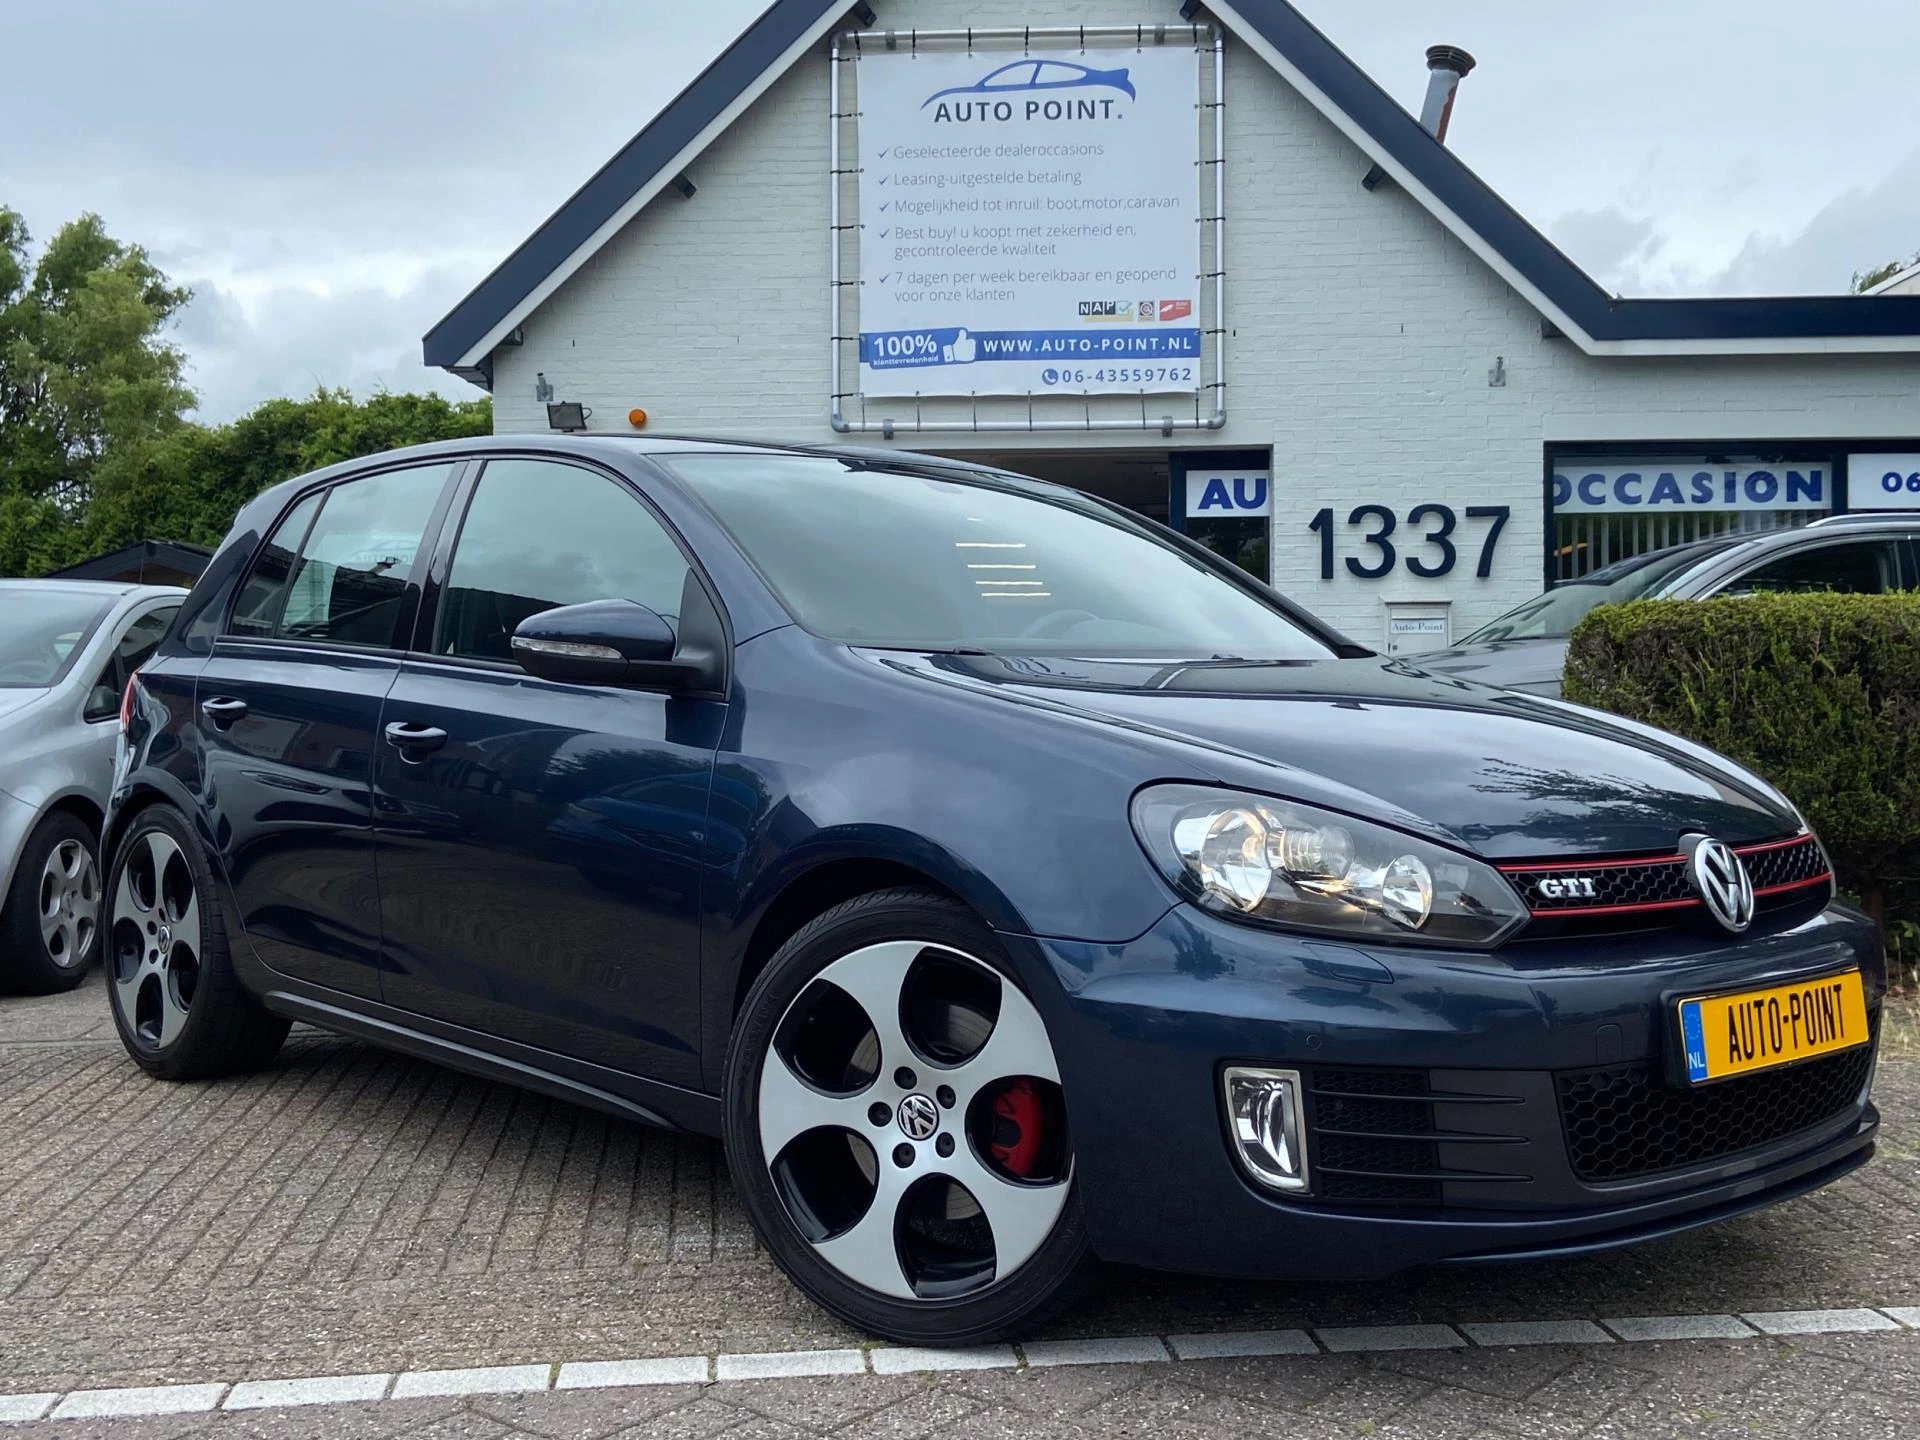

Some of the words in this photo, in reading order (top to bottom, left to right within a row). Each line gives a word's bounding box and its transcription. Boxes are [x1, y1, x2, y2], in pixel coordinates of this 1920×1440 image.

[934, 101, 1012, 122] AUTO
[894, 145, 991, 159] Geselecteerde
[995, 143, 1104, 157] dealeroccasions
[894, 171, 1024, 188] Leasing-uitgestelde
[1028, 169, 1082, 185] betaling
[895, 199, 978, 215] Mogelijkheid
[983, 199, 1001, 211] tot
[1047, 196, 1180, 211] boot,motor,caravan
[895, 226, 925, 239] Best
[928, 225, 956, 241] buy!
[960, 228, 969, 238] u
[973, 224, 1012, 240] koopt
[1016, 226, 1042, 238] met
[1046, 224, 1112, 237] zekerheid
[894, 244, 999, 261] gecontroleerde
[1002, 242, 1056, 256] kwaliteit
[895, 271, 903, 283] 7
[907, 271, 949, 287] dagen
[953, 272, 976, 286] per
[980, 269, 1015, 283] week
[1018, 268, 1091, 282] bereikbaar
[1095, 270, 1112, 281] en
[1116, 267, 1177, 284] geopend
[894, 291, 924, 302] voor
[929, 290, 962, 301] onze
[966, 288, 1015, 301] klanten
[1079, 301, 1116, 315] NAP
[873, 334, 938, 357] 100%
[983, 337, 1192, 353] WWW.AUTO-POINT.NL
[1062, 368, 1191, 383] 06-43559762
[1308, 503, 1510, 580] 1337
[1392, 622, 1443, 632] Auto-Point
[1537, 877, 1597, 900] GTI
[1728, 984, 1845, 1064] AUTO-POINT
[1689, 1051, 1706, 1070] NL
